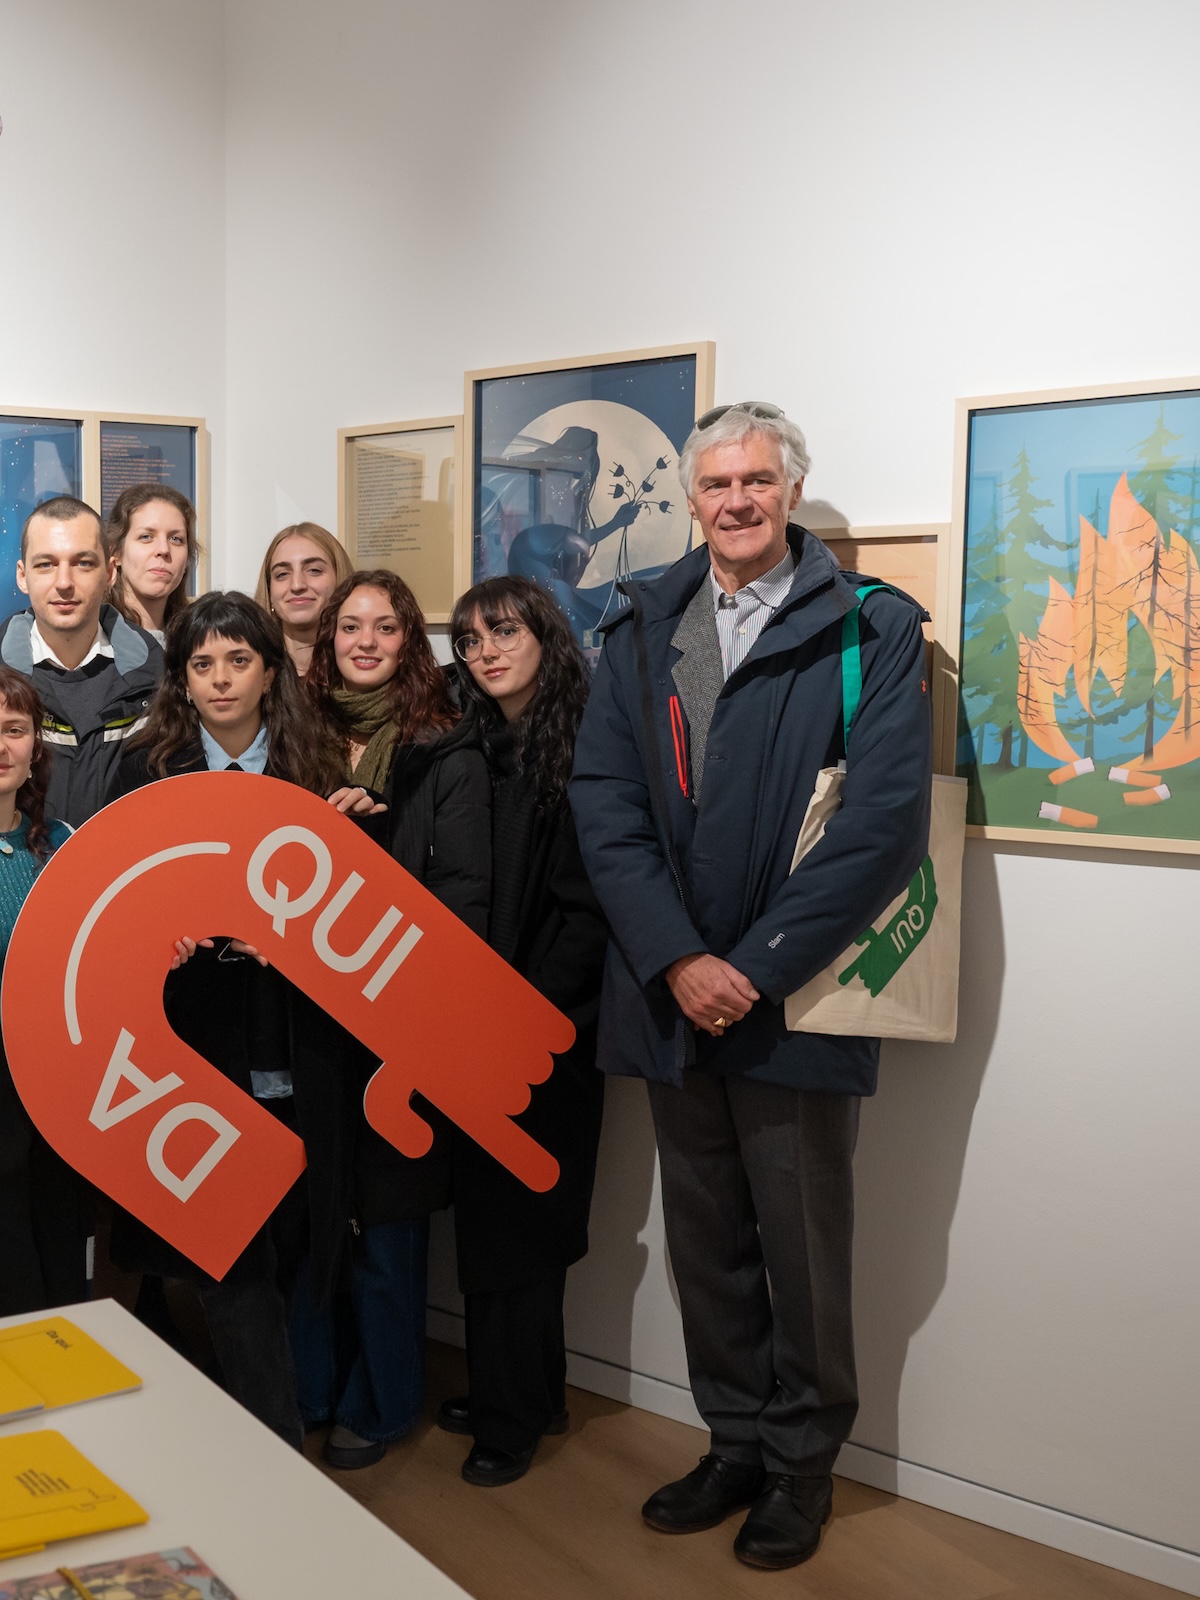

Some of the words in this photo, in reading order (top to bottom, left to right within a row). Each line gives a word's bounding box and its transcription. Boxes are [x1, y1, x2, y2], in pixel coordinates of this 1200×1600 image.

[768, 932, 786, 949] Slam
[890, 904, 925, 954] QUI
[88, 1026, 242, 1203] DA
[247, 825, 424, 1002] QUI
[46, 1330, 59, 1339] Da
